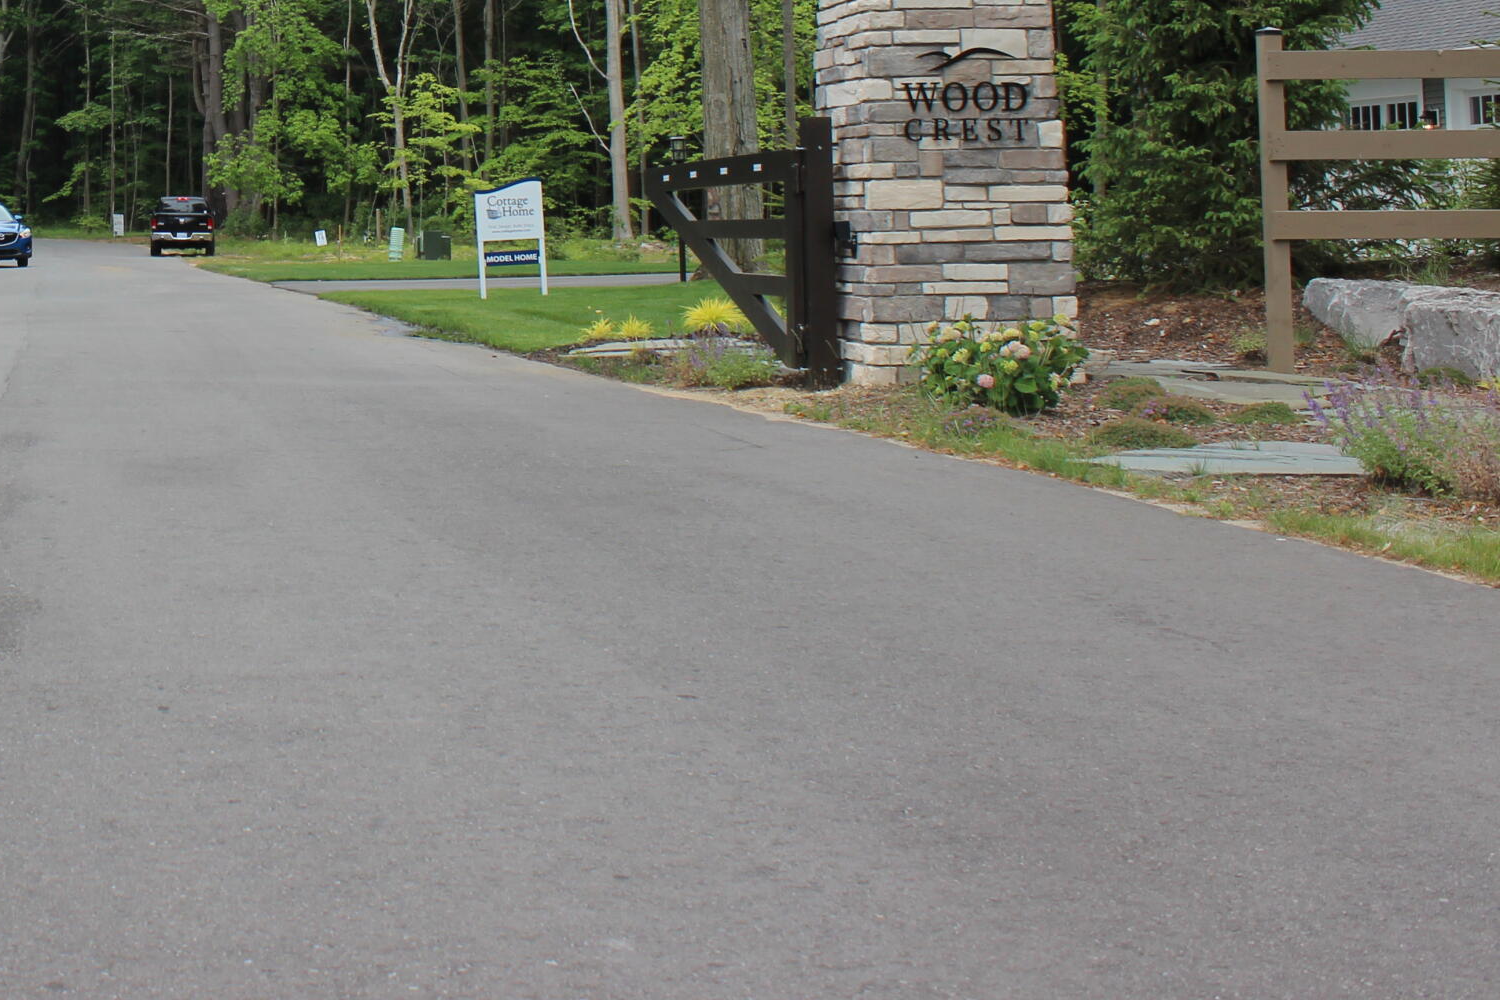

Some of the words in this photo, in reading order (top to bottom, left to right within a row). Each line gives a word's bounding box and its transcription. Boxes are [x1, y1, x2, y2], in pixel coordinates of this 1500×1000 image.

[901, 81, 1028, 113] WOOD
[904, 117, 1029, 142] CREST
[487, 195, 528, 208] Cottage
[502, 206, 534, 216] Home
[514, 253, 537, 261] HOME
